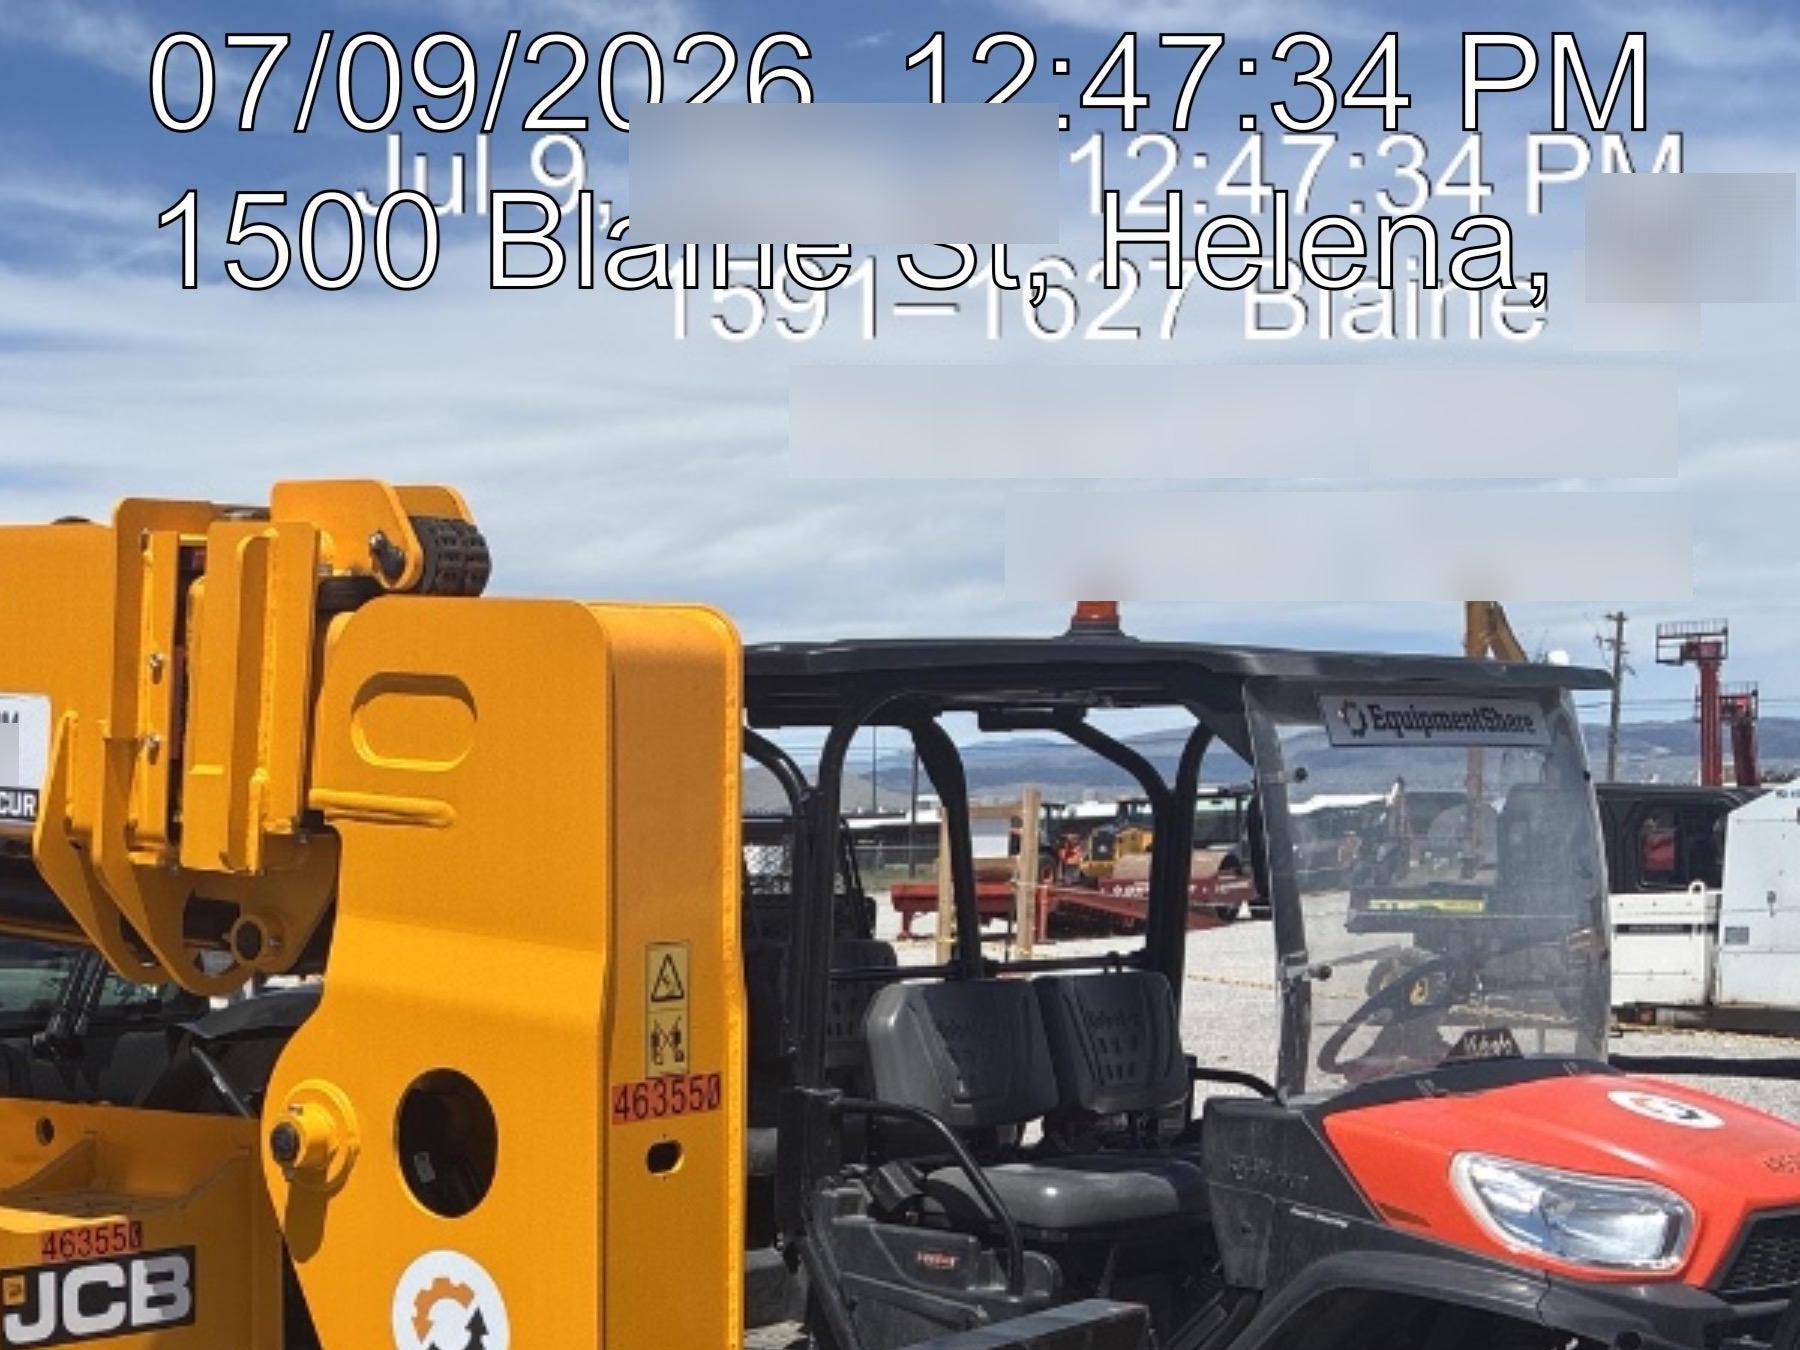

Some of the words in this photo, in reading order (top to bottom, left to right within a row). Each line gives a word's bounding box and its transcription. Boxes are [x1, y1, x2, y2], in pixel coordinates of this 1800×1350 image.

[1367, 704, 1536, 738] EquipmentShare
[614, 1073, 721, 1121] 463550
[41, 1221, 142, 1261] 463550
[3, 1255, 193, 1345] JCB
